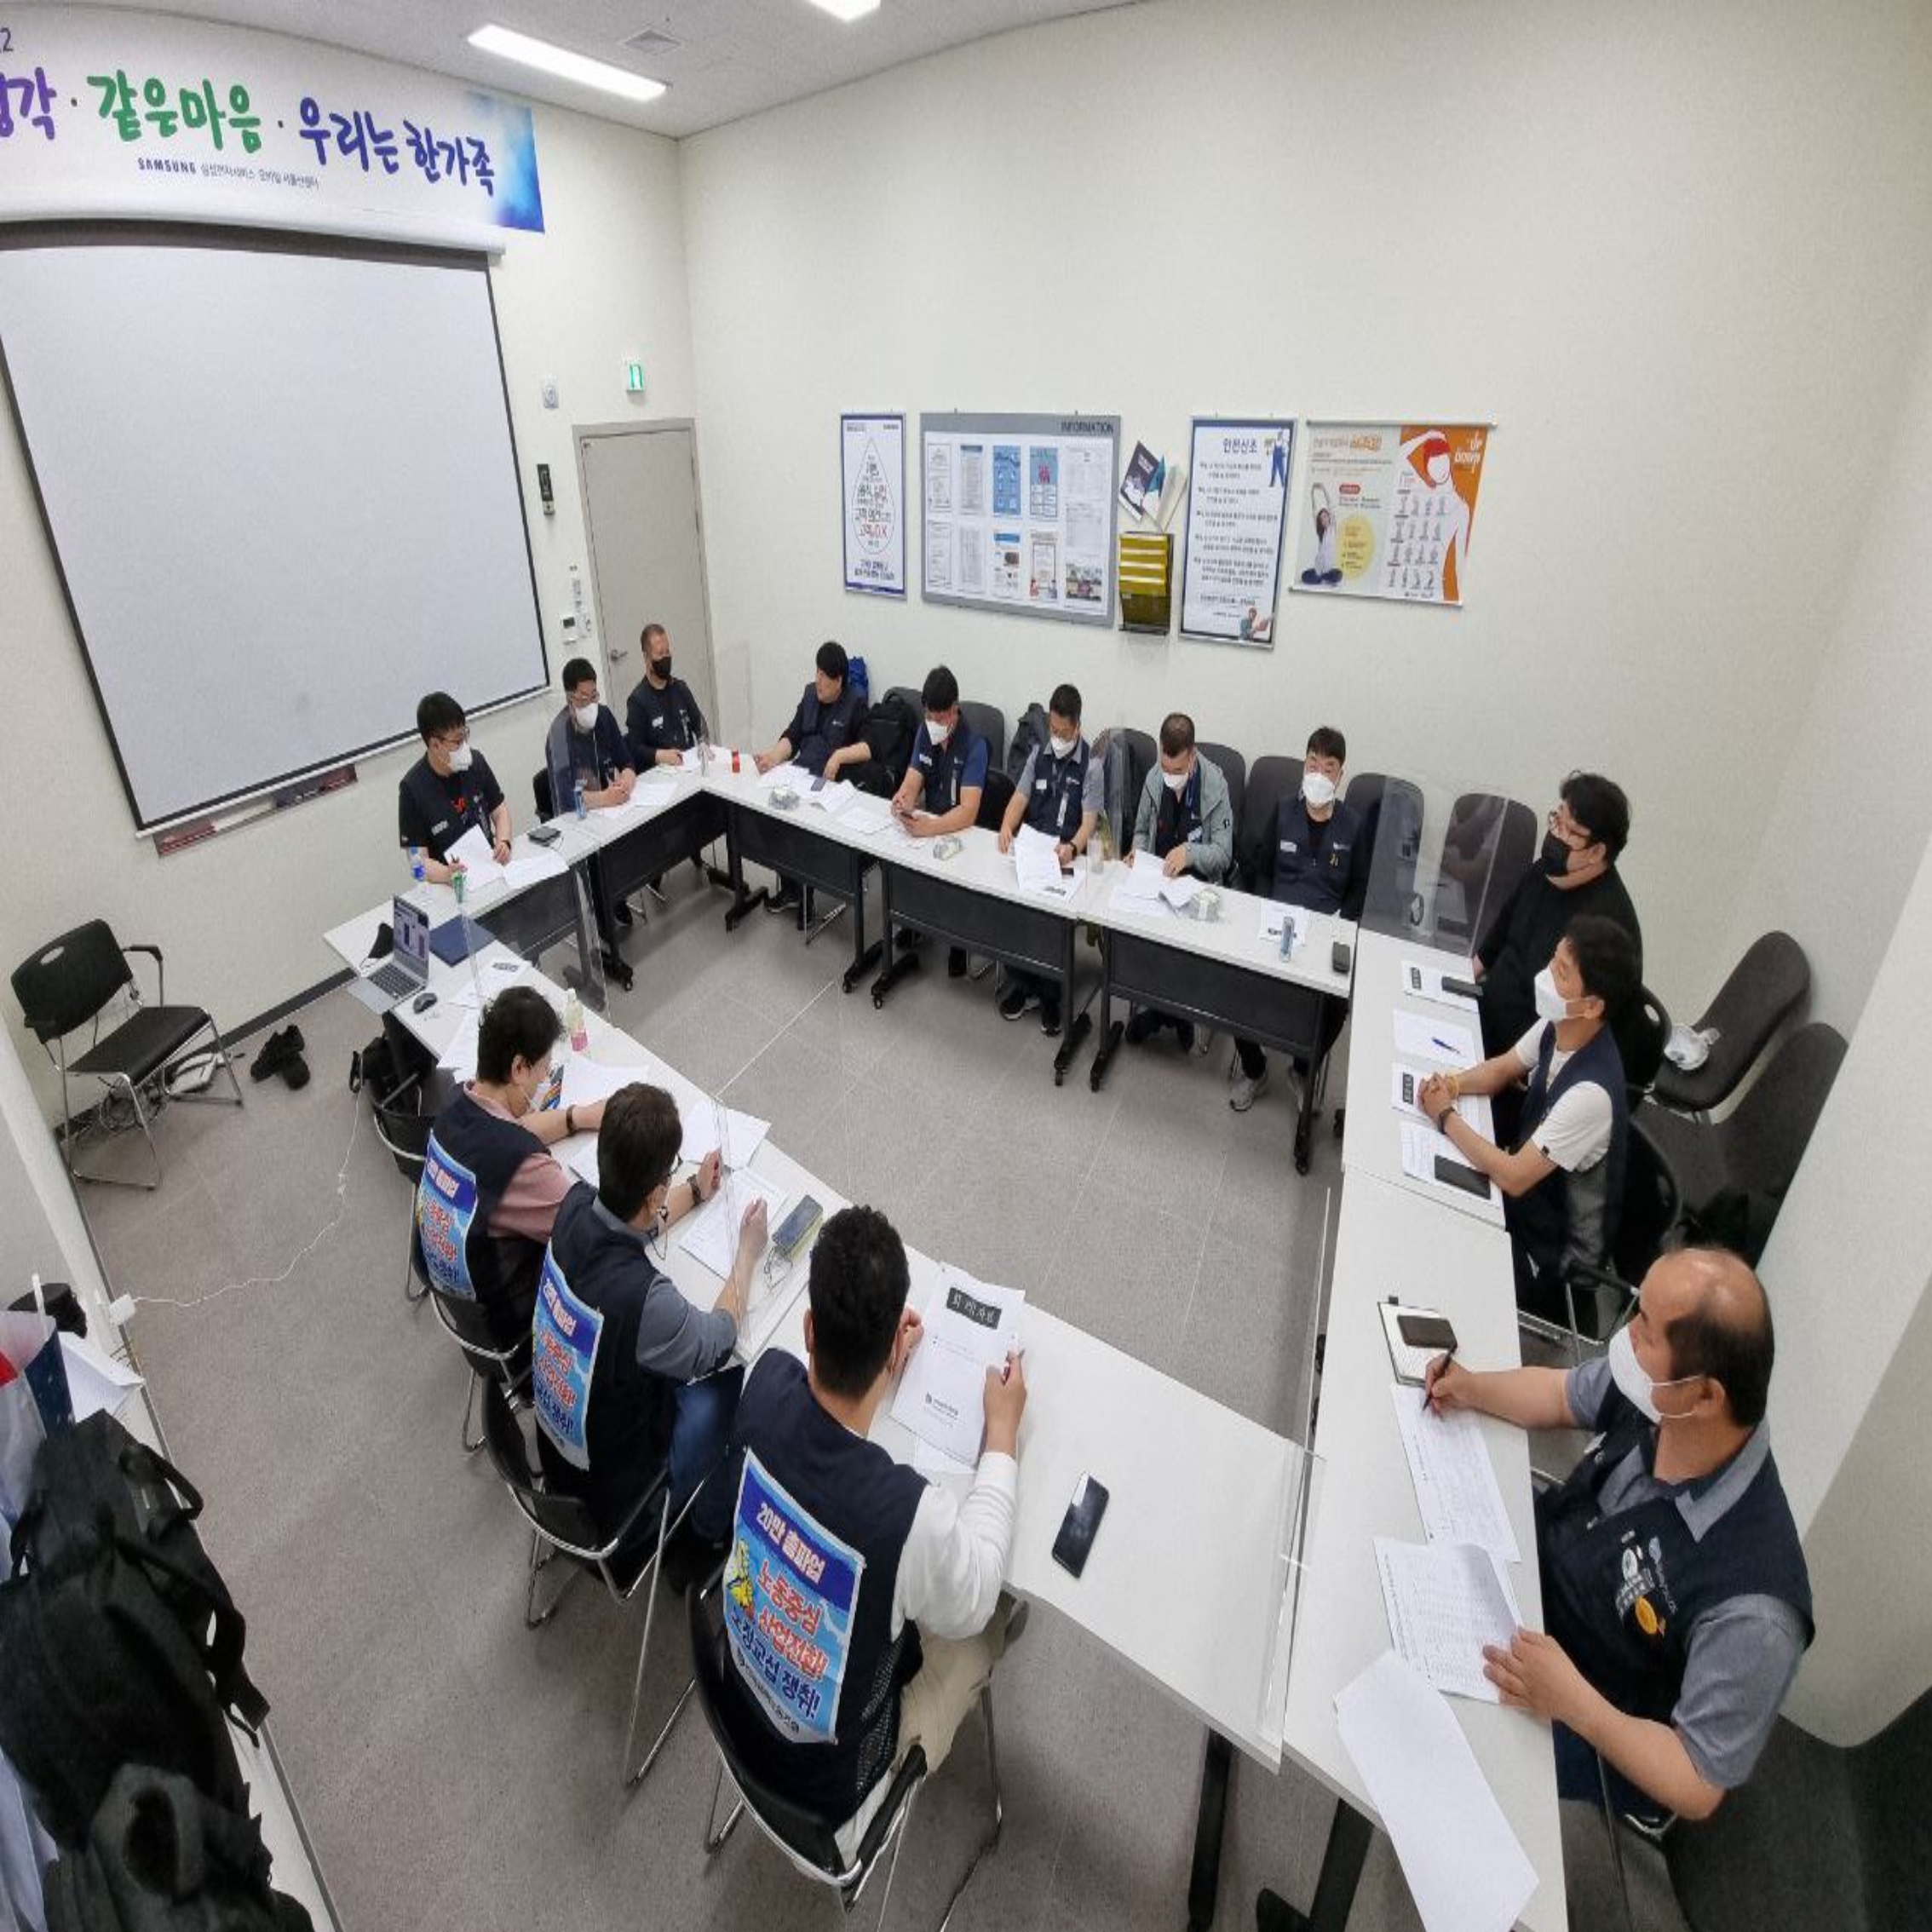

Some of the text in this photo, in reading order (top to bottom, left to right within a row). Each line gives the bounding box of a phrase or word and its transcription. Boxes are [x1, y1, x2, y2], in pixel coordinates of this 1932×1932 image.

[87, 69, 262, 157] 같은마음
[300, 96, 400, 175] 우리는
[403, 119, 495, 197] 한가족
[137, 158, 197, 175] SAMSUNG
[1061, 421, 1113, 435] INFORMATION
[756, 1502, 786, 1545] 20만
[756, 1559, 822, 1636] 노동중심
[782, 1670, 820, 1720] 쟁취!
